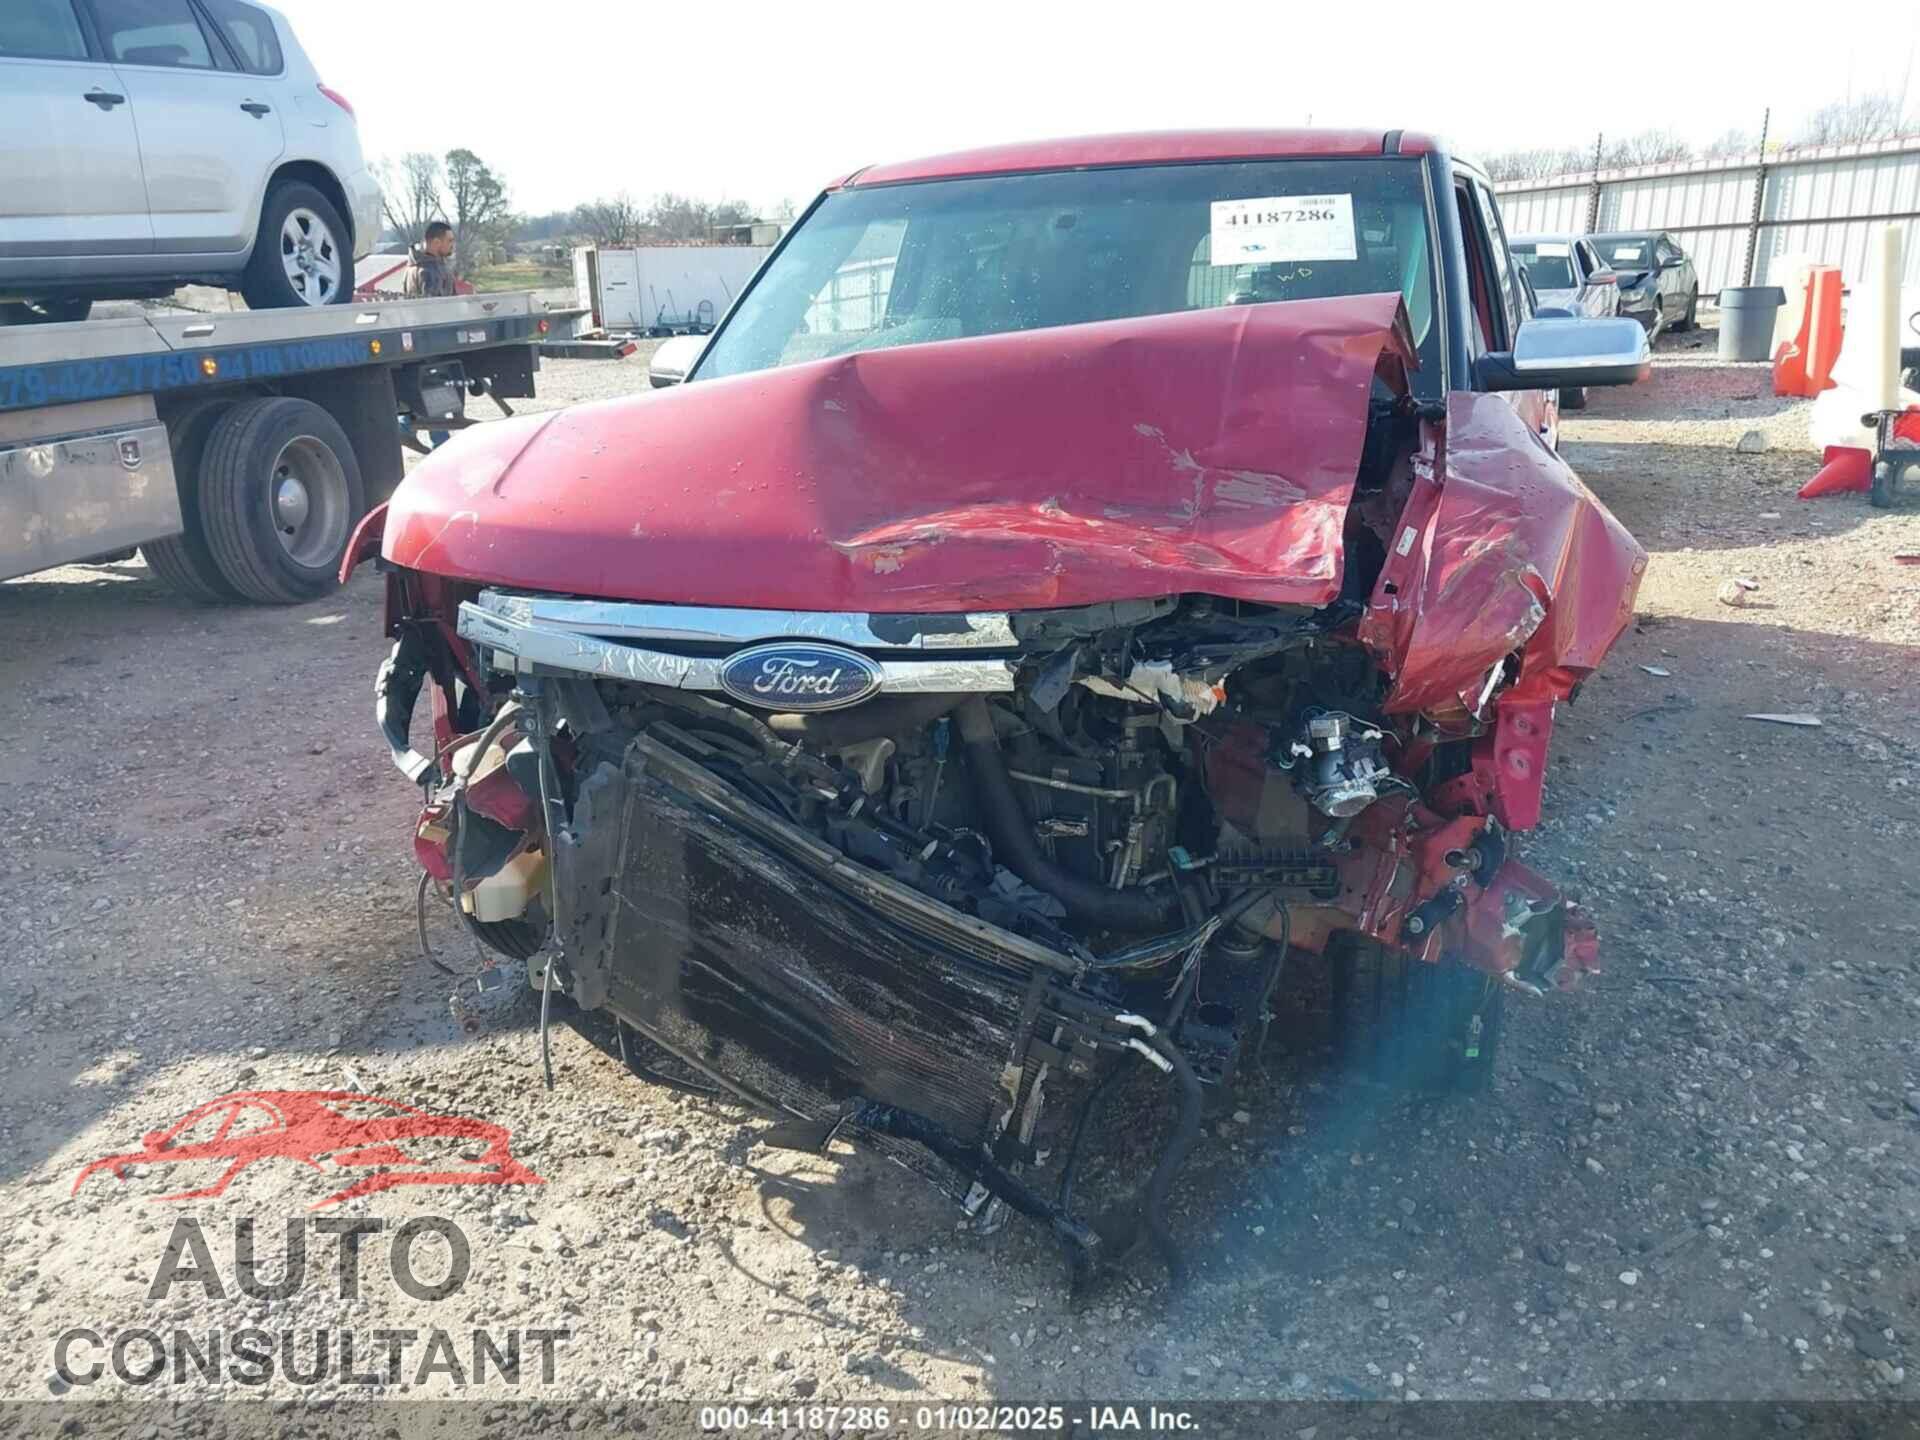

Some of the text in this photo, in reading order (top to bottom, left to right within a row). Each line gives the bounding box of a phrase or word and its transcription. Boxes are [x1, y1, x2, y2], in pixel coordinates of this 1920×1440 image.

[1225, 209, 1335, 226] 41187286
[285, 337, 369, 370] TOWING
[753, 657, 842, 694] Ford
